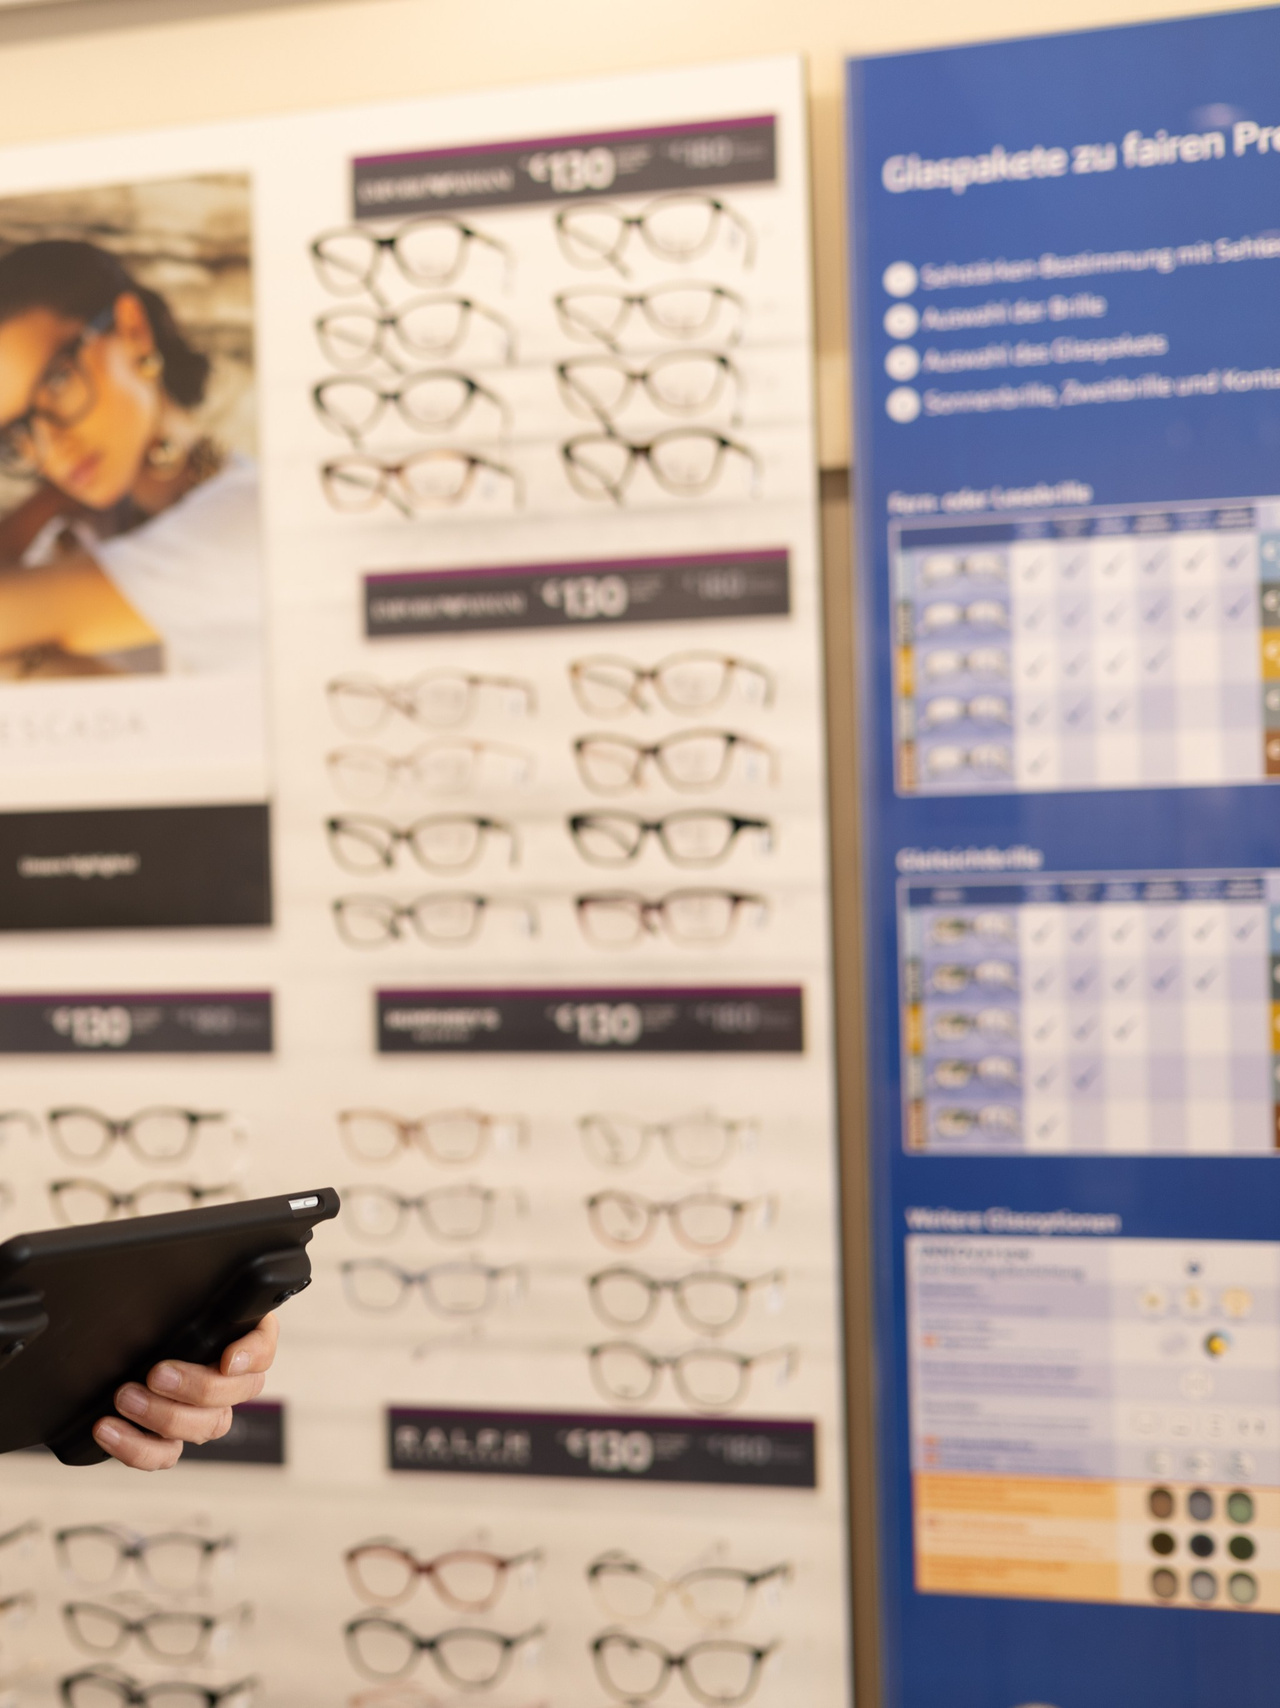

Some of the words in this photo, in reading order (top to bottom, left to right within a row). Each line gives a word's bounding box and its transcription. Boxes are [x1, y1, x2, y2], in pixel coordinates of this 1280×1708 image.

[882, 145, 1068, 194] Glaspakete
[1072, 142, 1117, 174] zu
[1123, 130, 1225, 168] fairen
